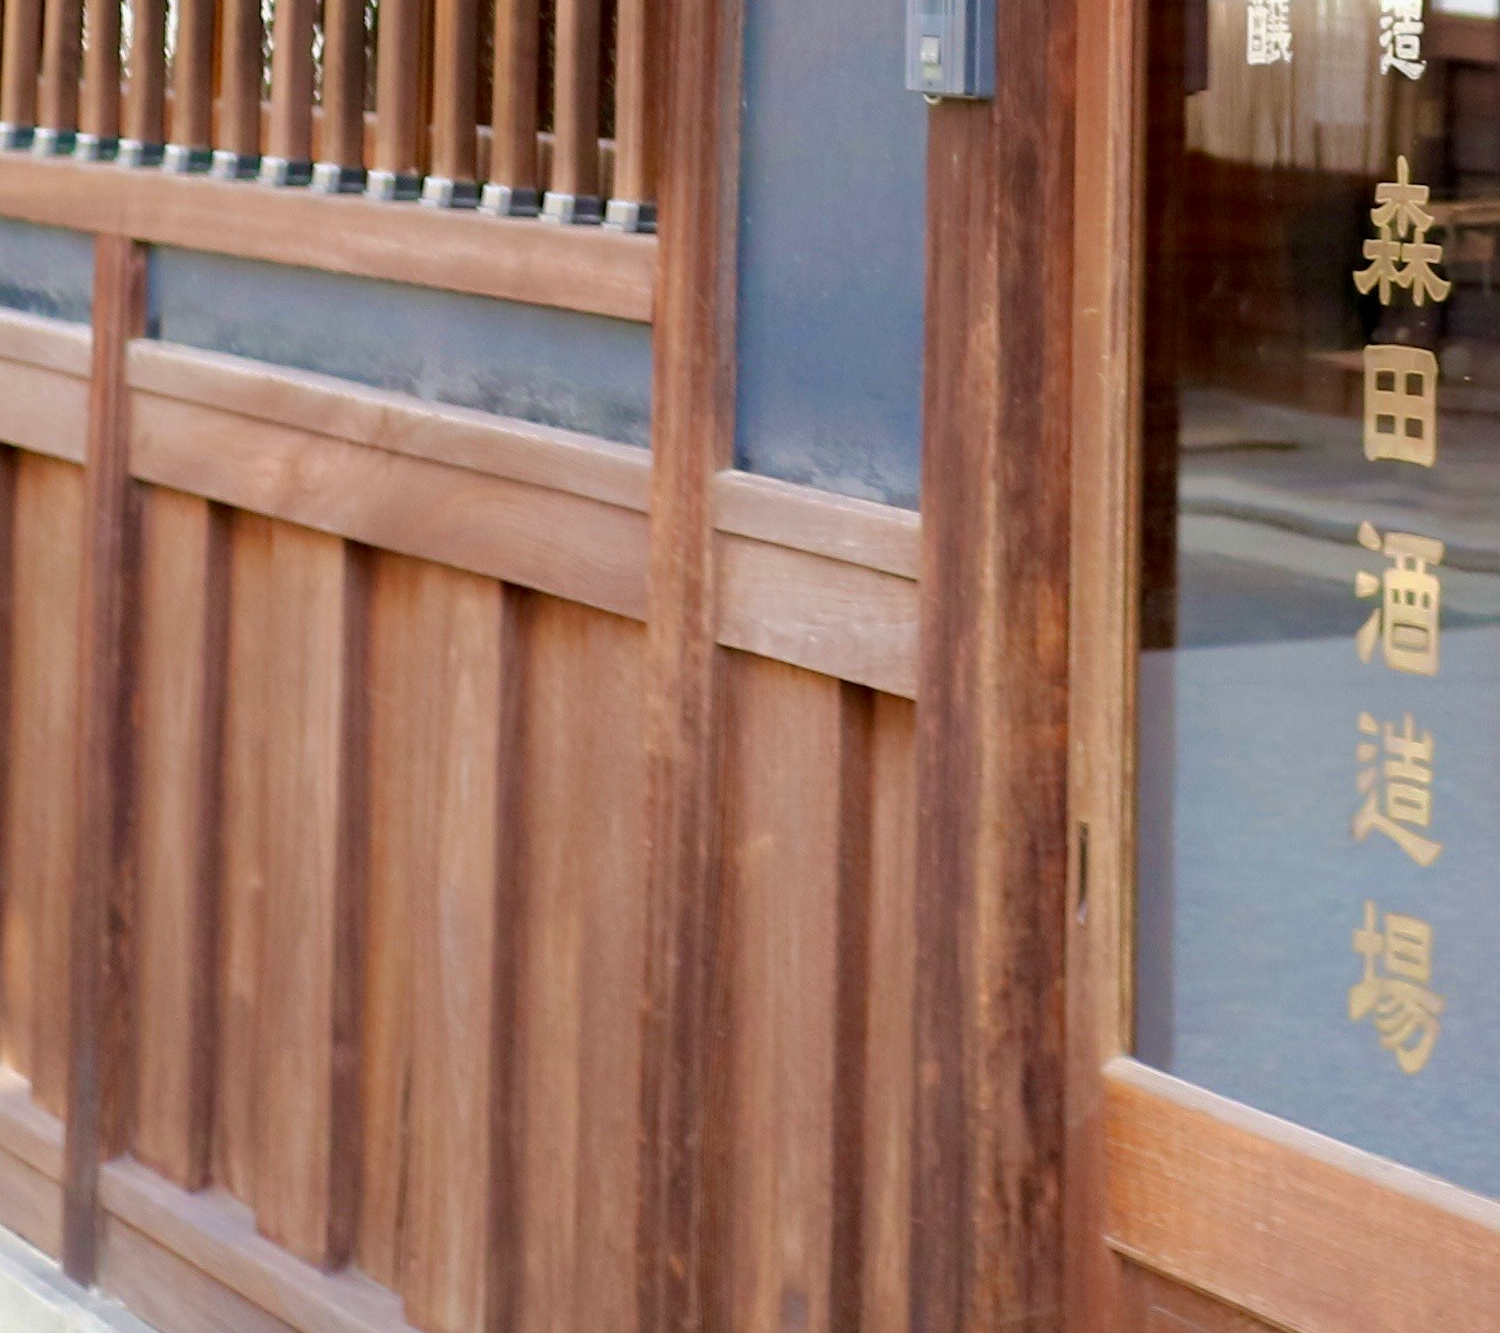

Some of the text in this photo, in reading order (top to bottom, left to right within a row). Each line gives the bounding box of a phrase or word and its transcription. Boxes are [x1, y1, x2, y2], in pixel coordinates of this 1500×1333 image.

[1347, 154, 1453, 1075] 森田酒造場
